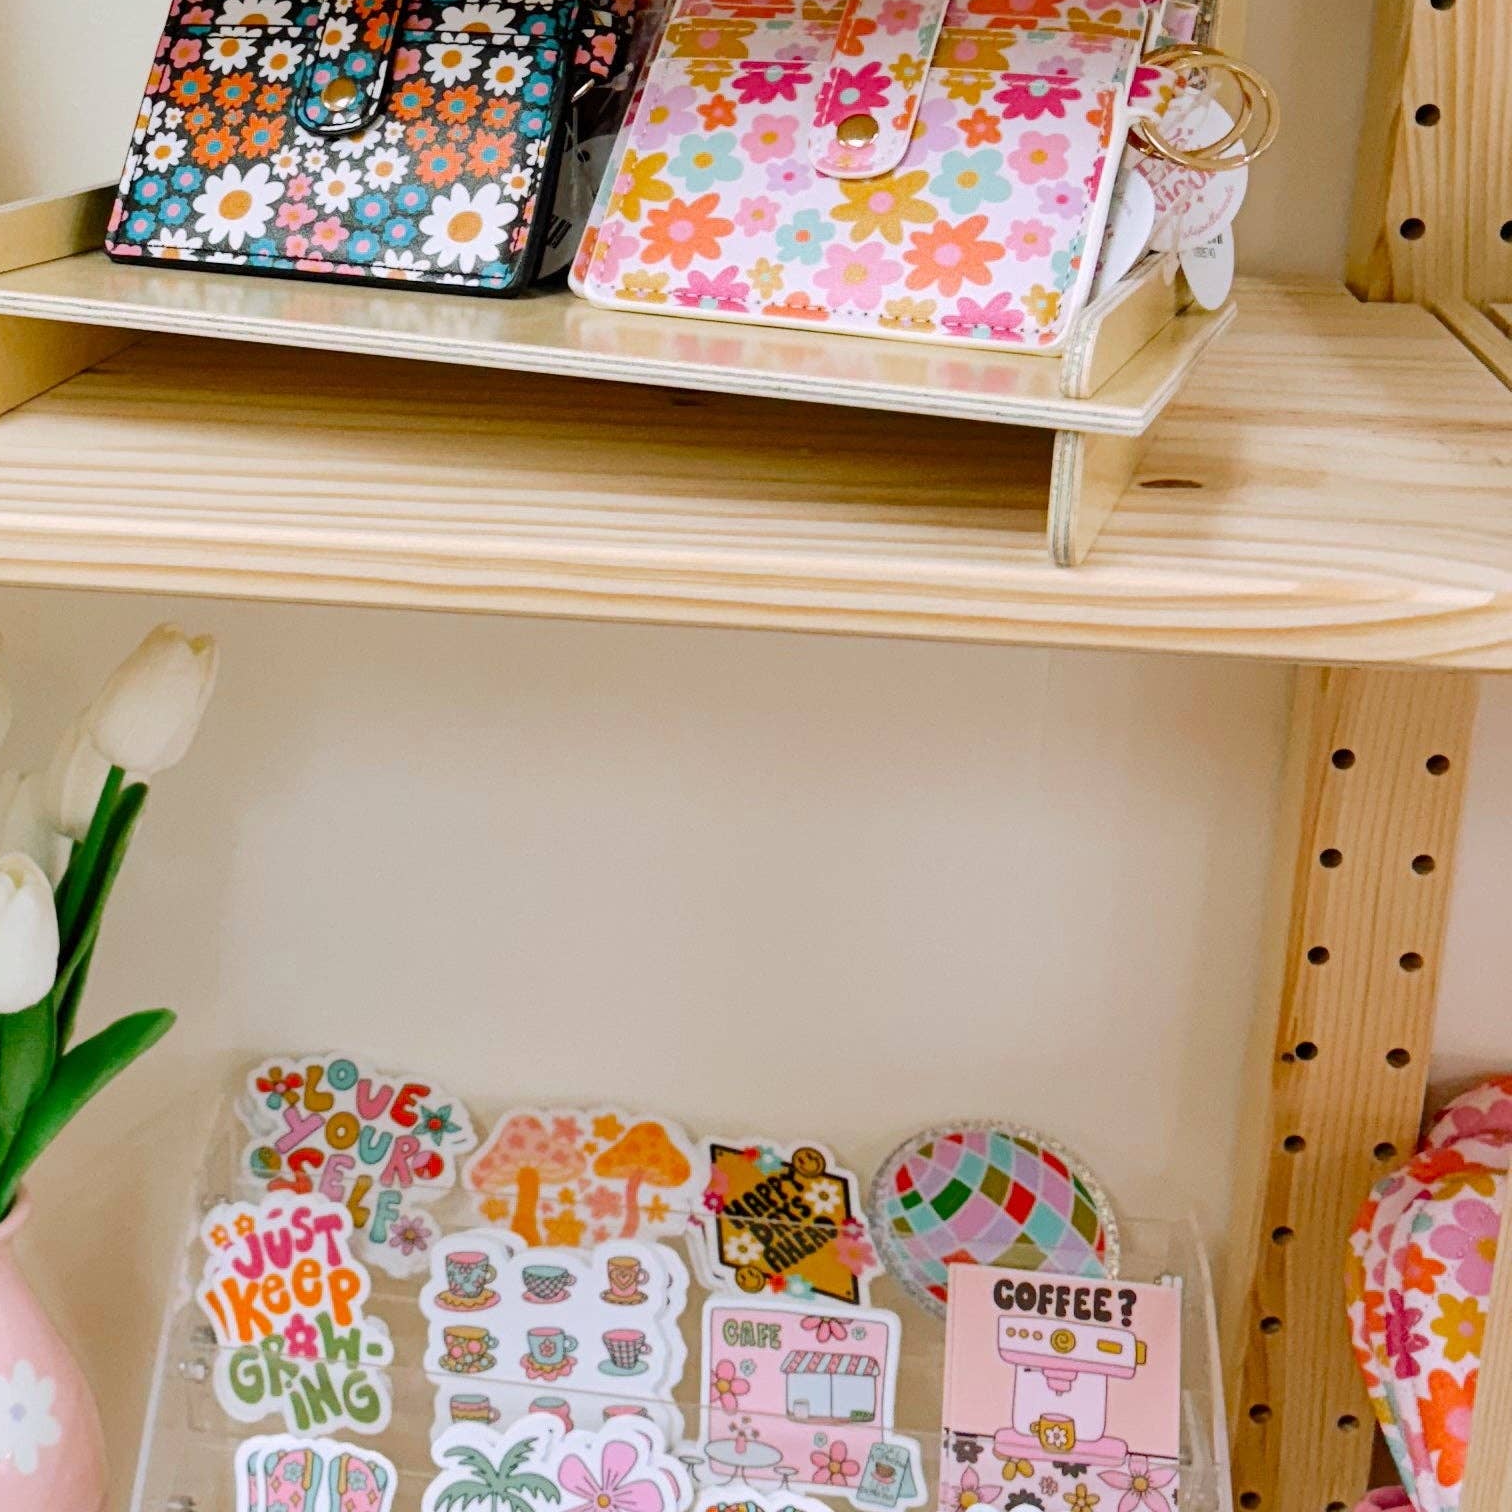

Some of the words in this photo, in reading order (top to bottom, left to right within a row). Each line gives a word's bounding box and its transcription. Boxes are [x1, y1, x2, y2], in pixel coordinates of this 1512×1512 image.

[304, 1058, 431, 1127] LOVE
[274, 1106, 421, 1188] YOUR
[232, 1207, 343, 1279] JUST
[723, 1318, 783, 1350] CAFE
[993, 1279, 1137, 1327] COFFEE?
[290, 1361, 381, 1431] ING
